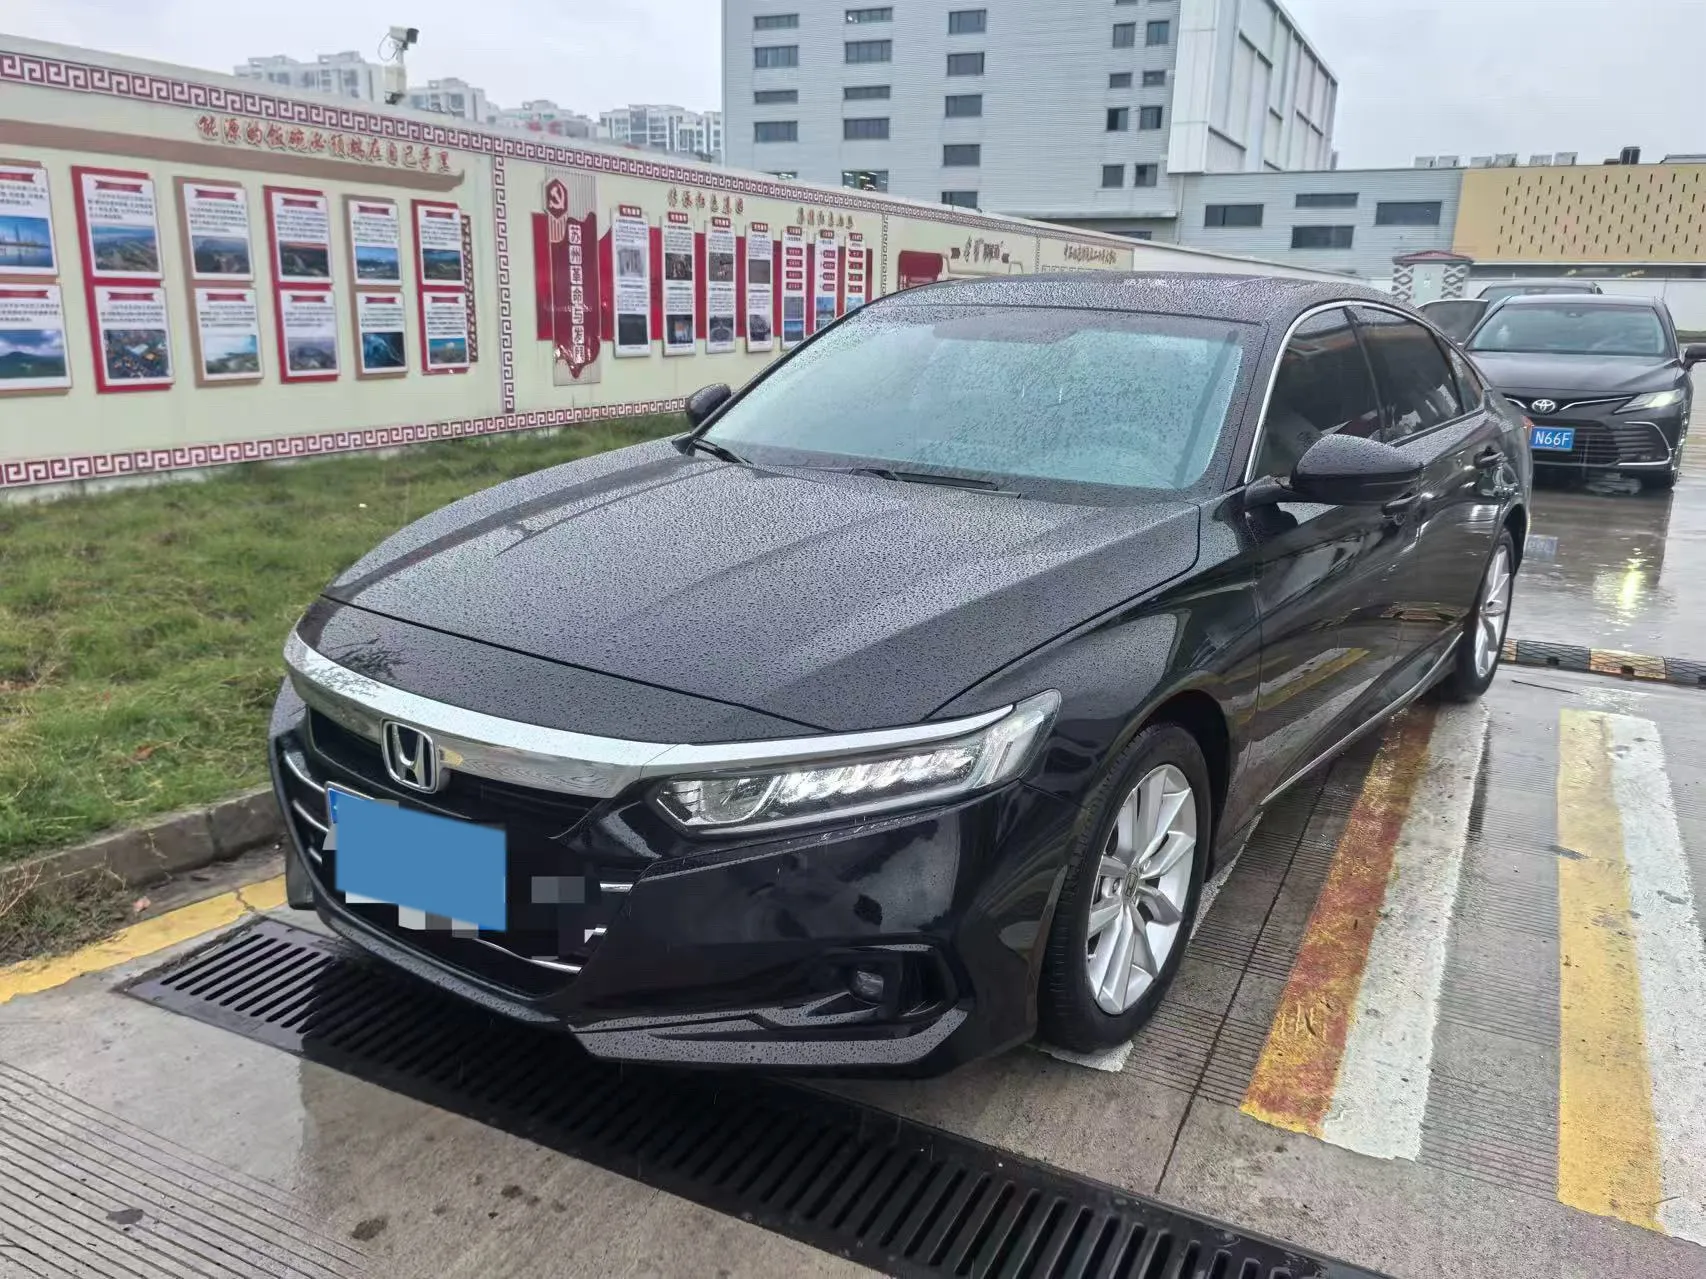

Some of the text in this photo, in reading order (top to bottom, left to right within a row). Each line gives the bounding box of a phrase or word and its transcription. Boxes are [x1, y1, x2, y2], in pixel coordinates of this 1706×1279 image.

[198, 115, 451, 171] 能源的饭碗必须端在自己手里
[1535, 431, 1572, 446] N66F
